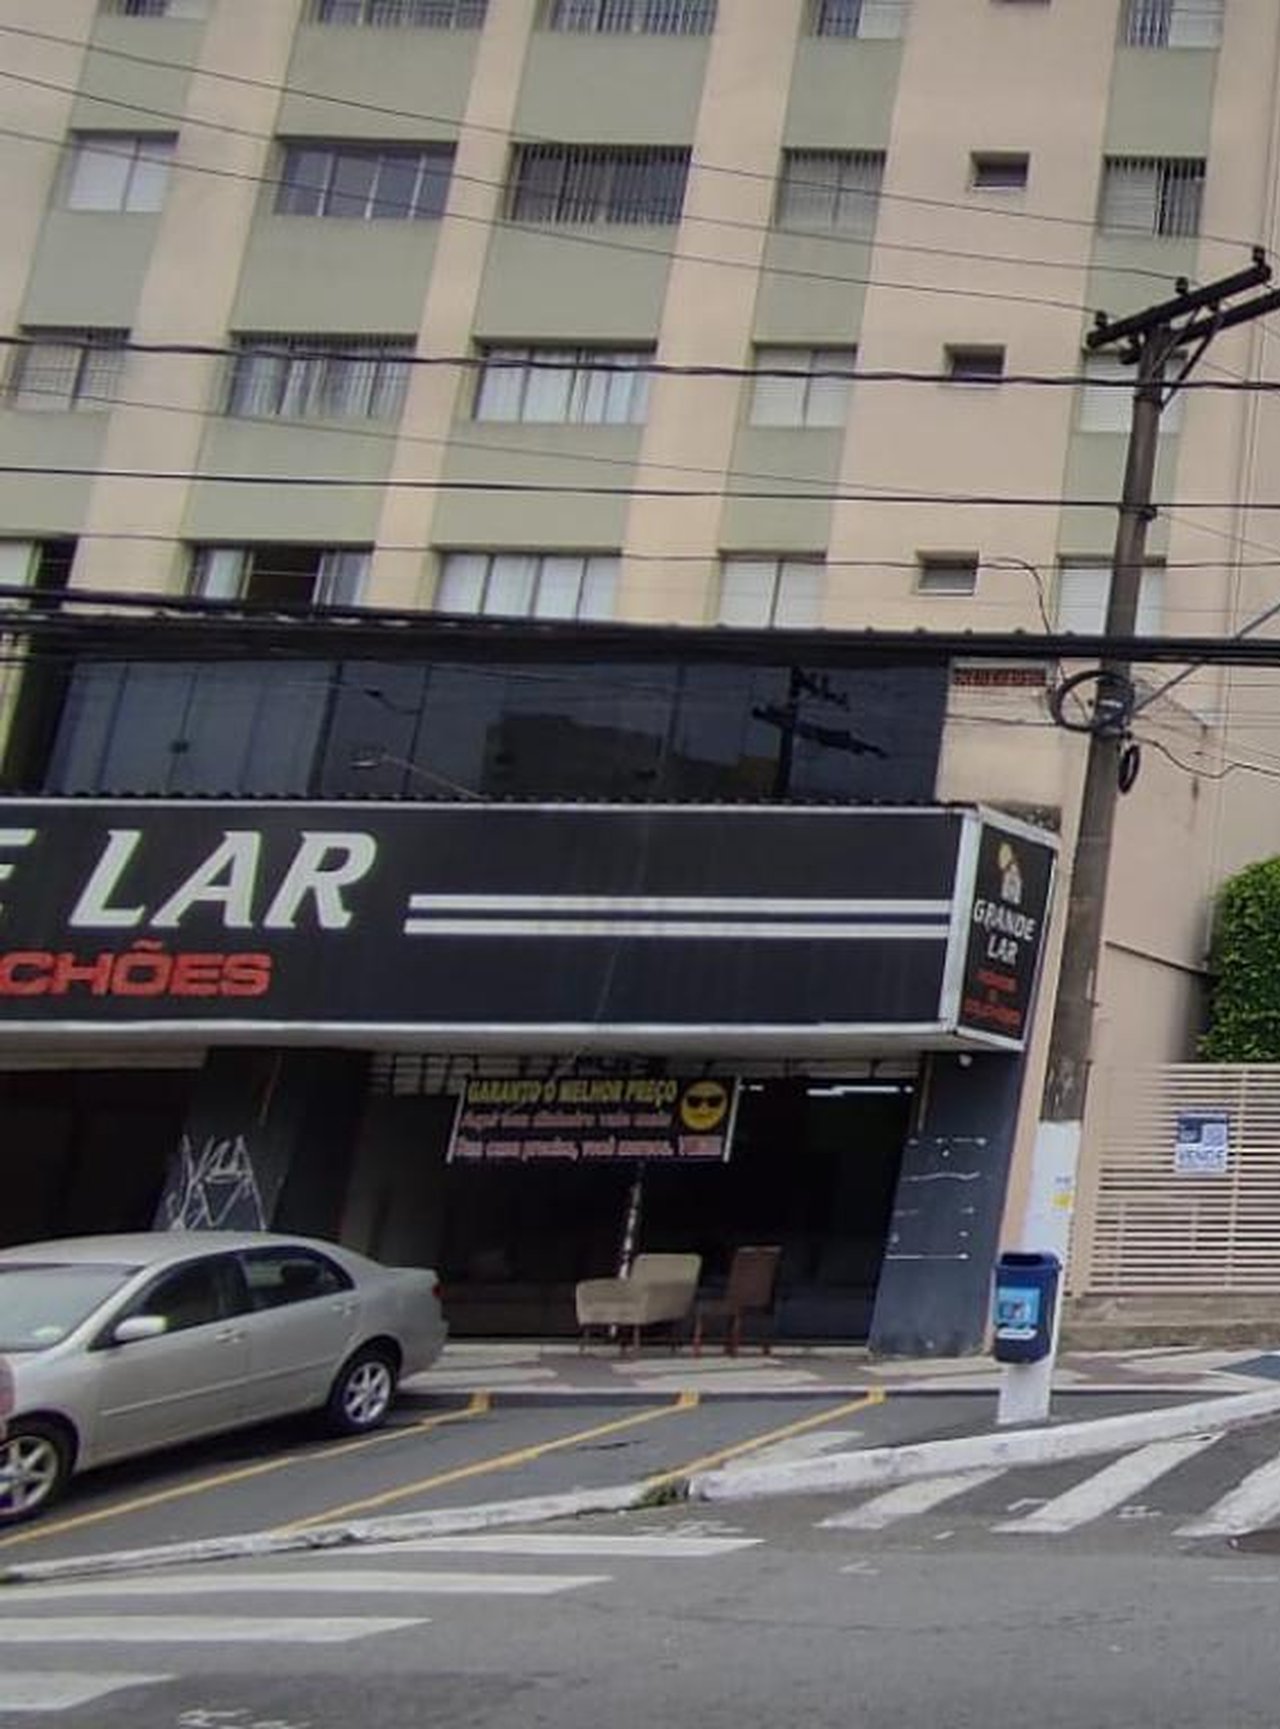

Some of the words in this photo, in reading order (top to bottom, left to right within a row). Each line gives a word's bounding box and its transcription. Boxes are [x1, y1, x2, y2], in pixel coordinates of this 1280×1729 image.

[69, 830, 377, 929] LAR
[973, 899, 1037, 941] GRANDE
[988, 936, 1019, 964] LAR
[467, 1080, 541, 1103] GARANTO
[544, 1081, 557, 1101] O
[558, 1080, 624, 1102] MELHOR
[625, 1079, 678, 1107] PREÇO
